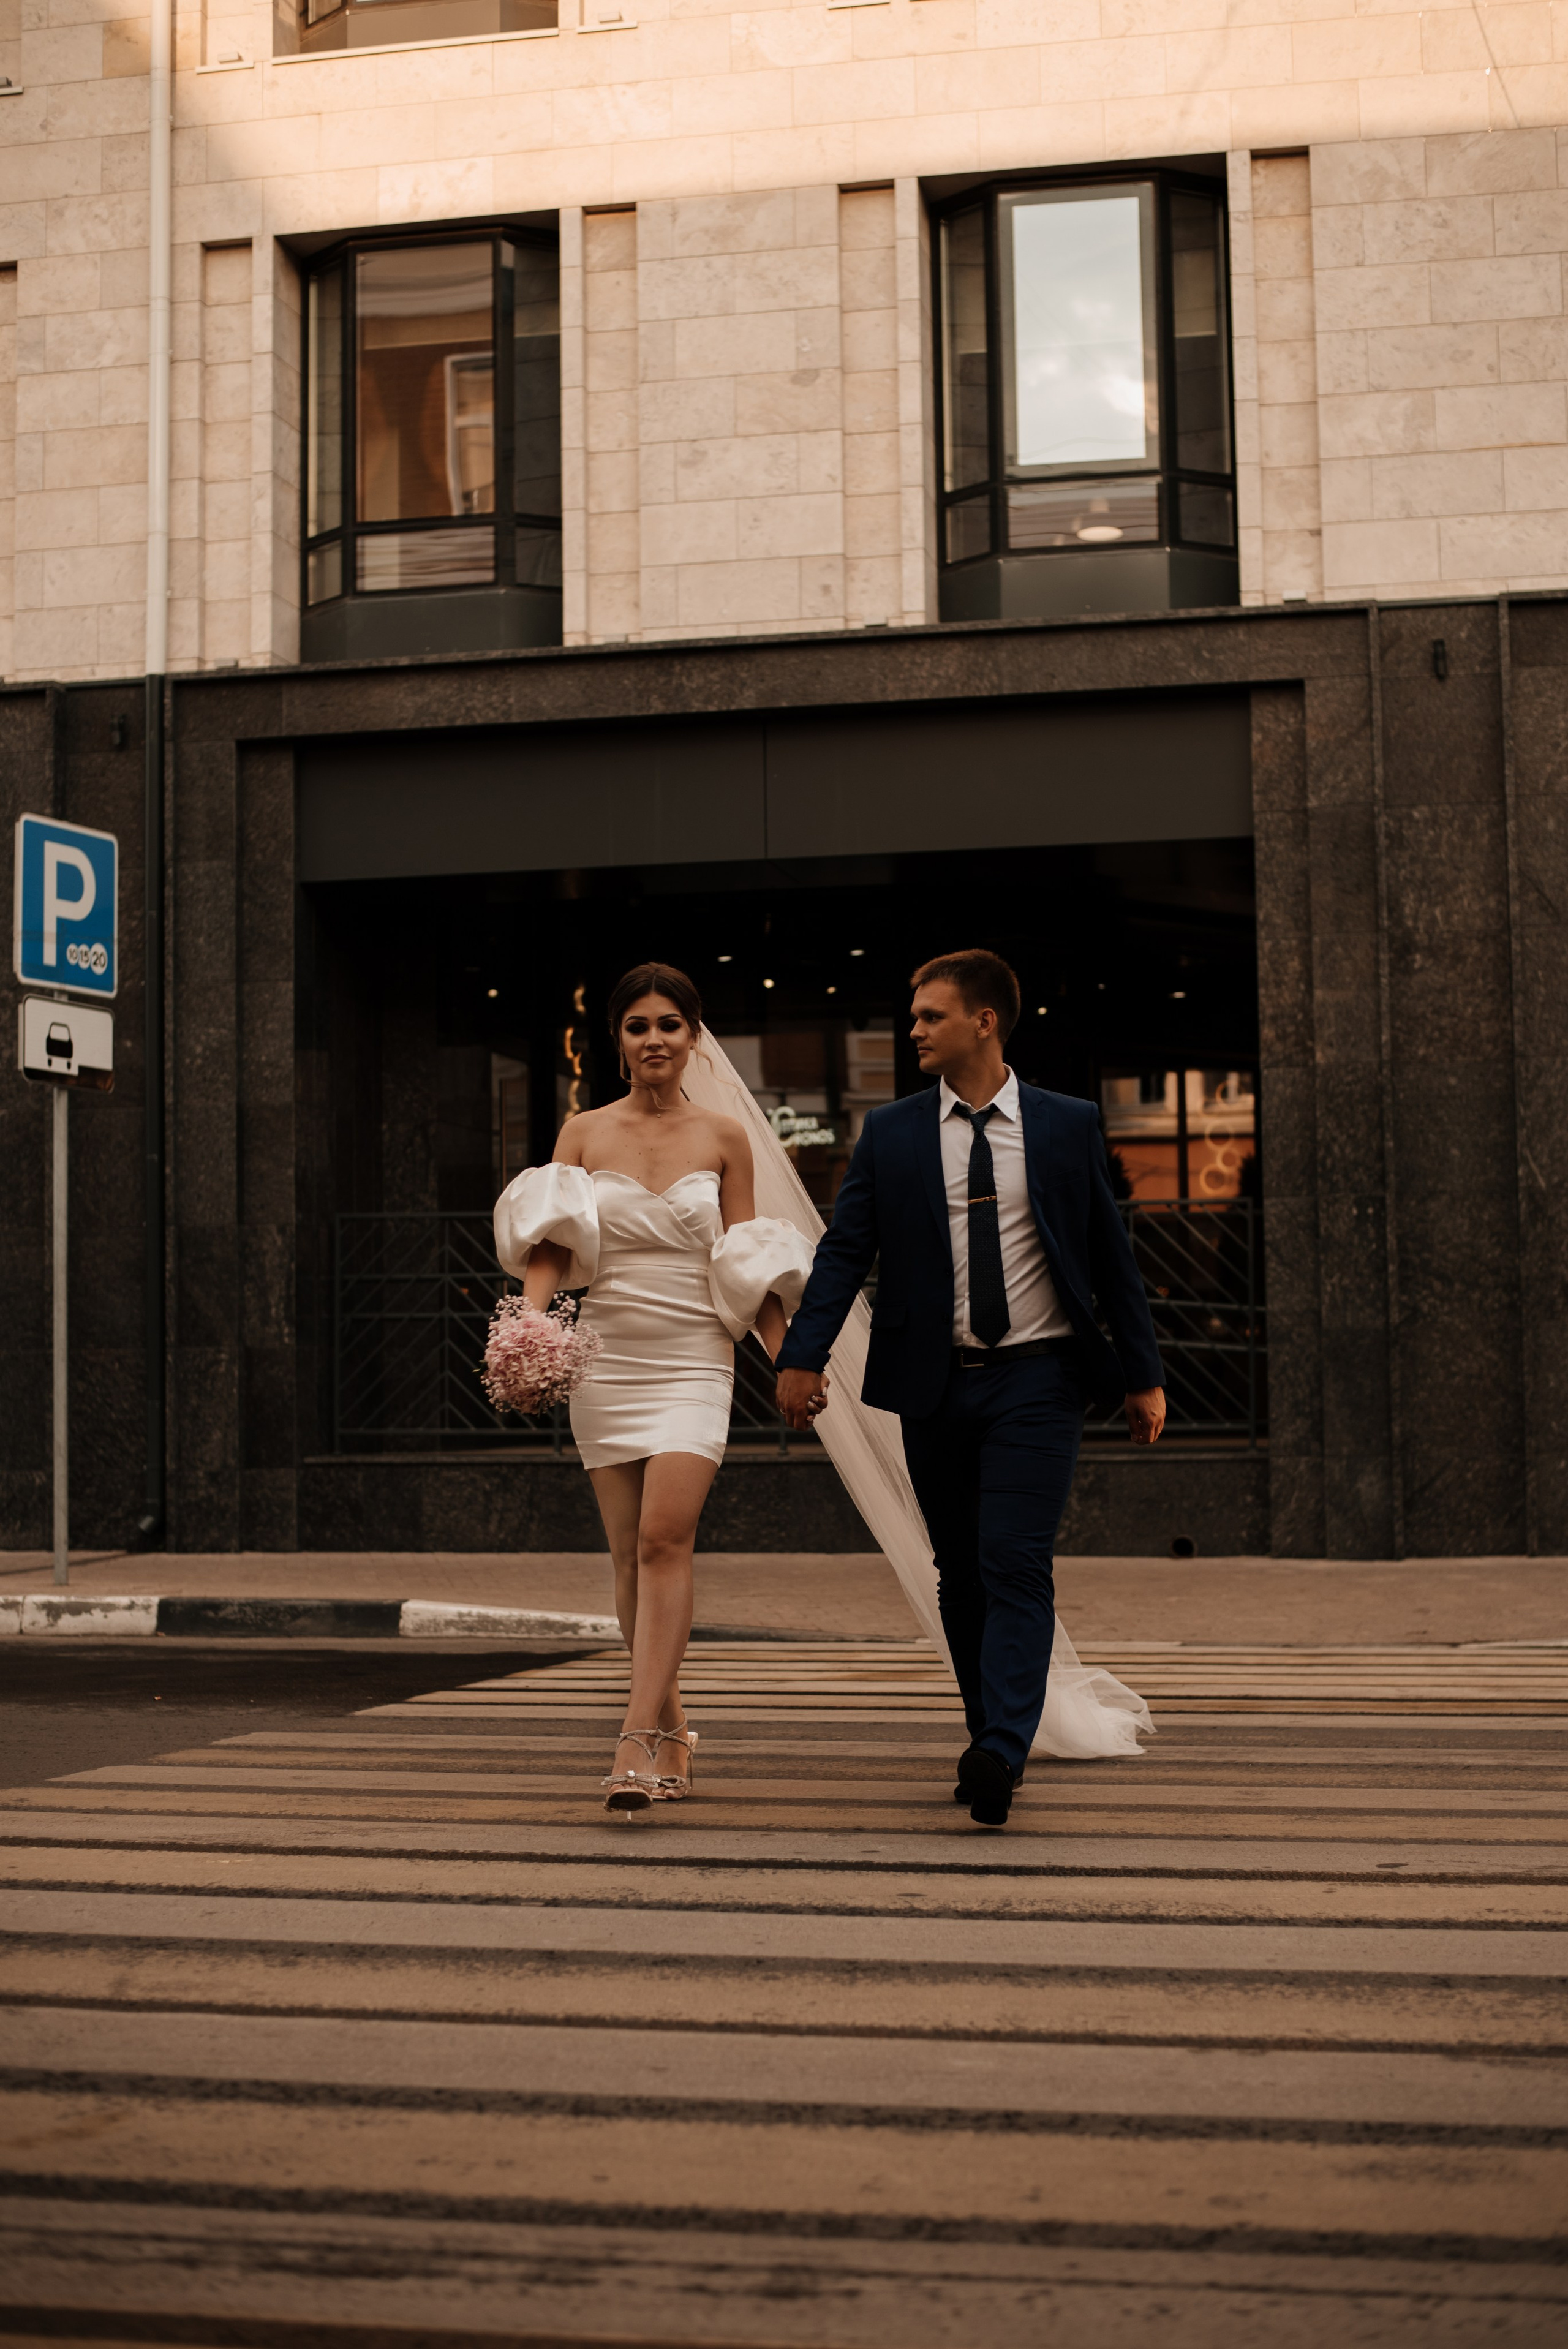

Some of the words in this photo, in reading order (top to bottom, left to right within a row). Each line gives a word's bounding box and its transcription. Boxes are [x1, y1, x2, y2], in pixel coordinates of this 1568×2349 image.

[43, 840, 96, 967] P
[69, 948, 78, 961] 10
[80, 949, 89, 964] 15
[92, 951, 106, 968] 20
